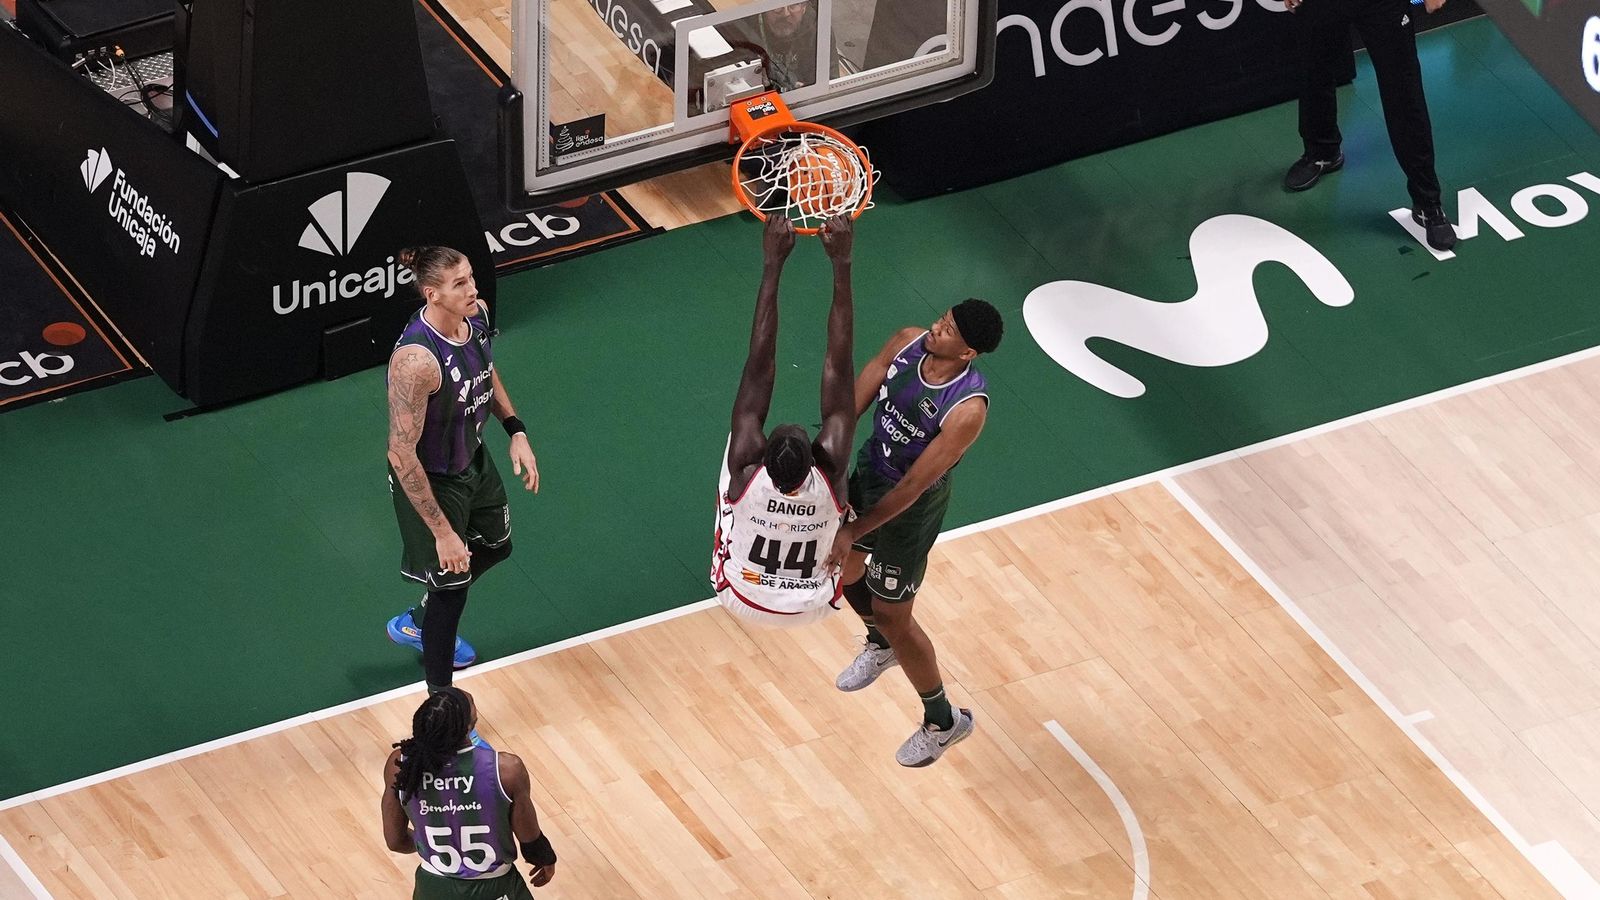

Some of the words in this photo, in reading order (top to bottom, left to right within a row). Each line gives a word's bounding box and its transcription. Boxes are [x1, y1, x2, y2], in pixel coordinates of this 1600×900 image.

[588, 0, 661, 76] desa
[108, 191, 157, 258] Unicaja
[113, 168, 180, 254] Fundación
[272, 255, 417, 315] Unicaja
[880, 414, 911, 445] álaga
[884, 401, 926, 439] Unicaja
[750, 515, 766, 527] AIR
[766, 498, 816, 516] BANGO
[748, 534, 818, 579] 44
[761, 578, 776, 588] DE
[422, 771, 475, 794] Perry
[424, 825, 497, 874] 55
